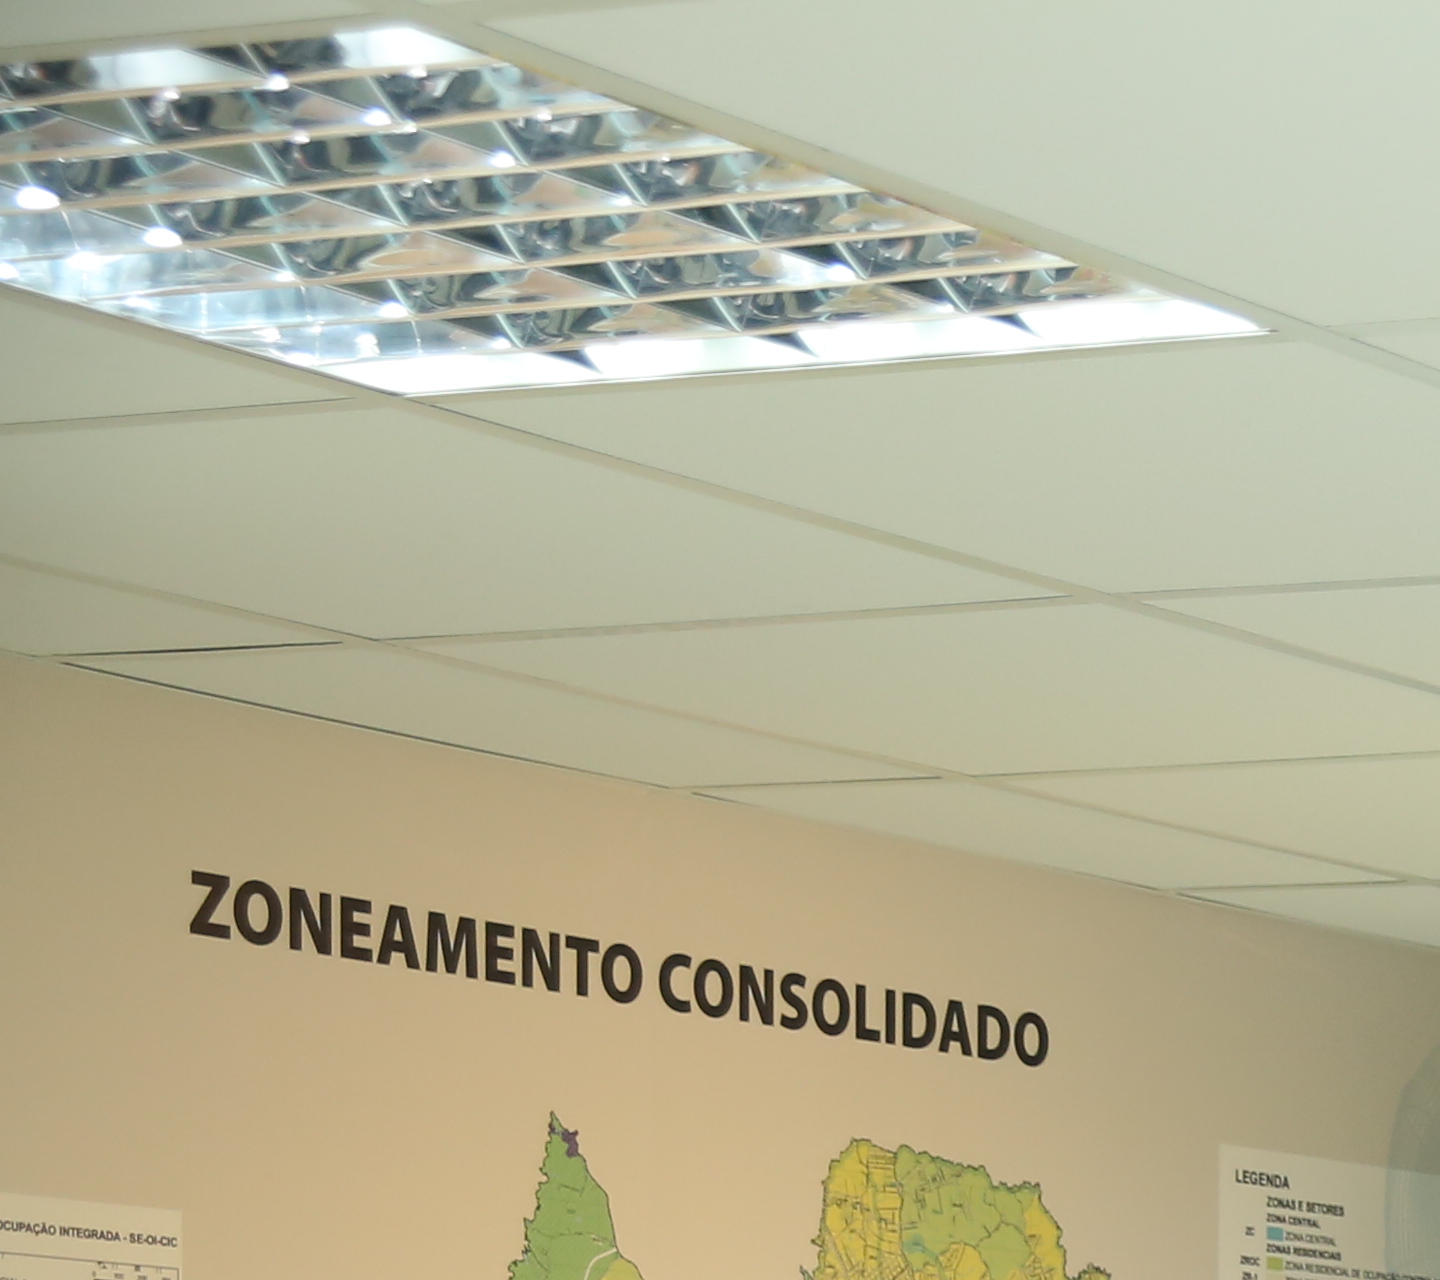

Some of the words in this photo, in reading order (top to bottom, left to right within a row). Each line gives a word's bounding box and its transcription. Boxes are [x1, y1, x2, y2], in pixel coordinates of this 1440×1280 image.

[189, 870, 643, 1005] ZONEAMENTO
[657, 953, 1052, 1069] CONSOLIDADO
[1235, 1169, 1290, 1189] LEGENDA
[1266, 1196, 1296, 1211] ZONAS
[1306, 1201, 1344, 1217] SETORES
[59, 1226, 121, 1242] INTEGRADA
[129, 1233, 178, 1247] SE-OI-CIC
